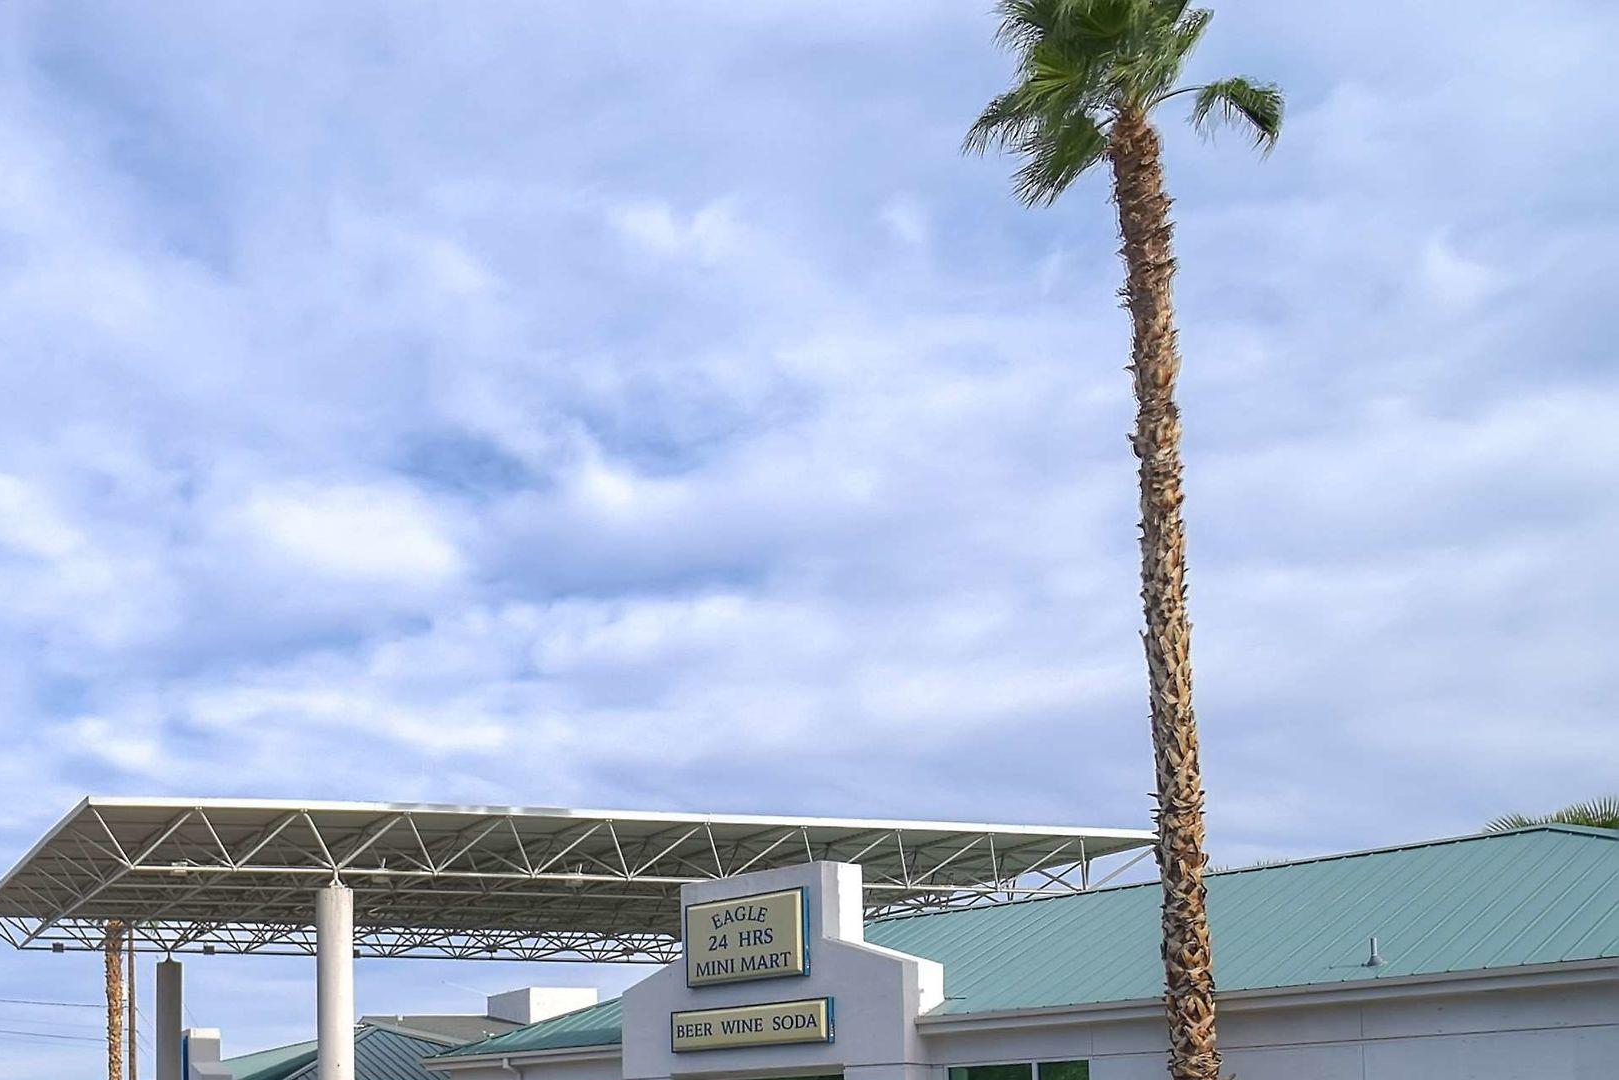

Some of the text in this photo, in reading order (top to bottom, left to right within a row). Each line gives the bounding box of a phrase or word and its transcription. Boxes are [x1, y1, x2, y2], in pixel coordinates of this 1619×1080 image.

[711, 905, 769, 930] EAGLE
[708, 927, 774, 952] 24 HRS
[696, 952, 791, 977] MINI MART
[677, 1013, 818, 1039] BEER WINE SODA
